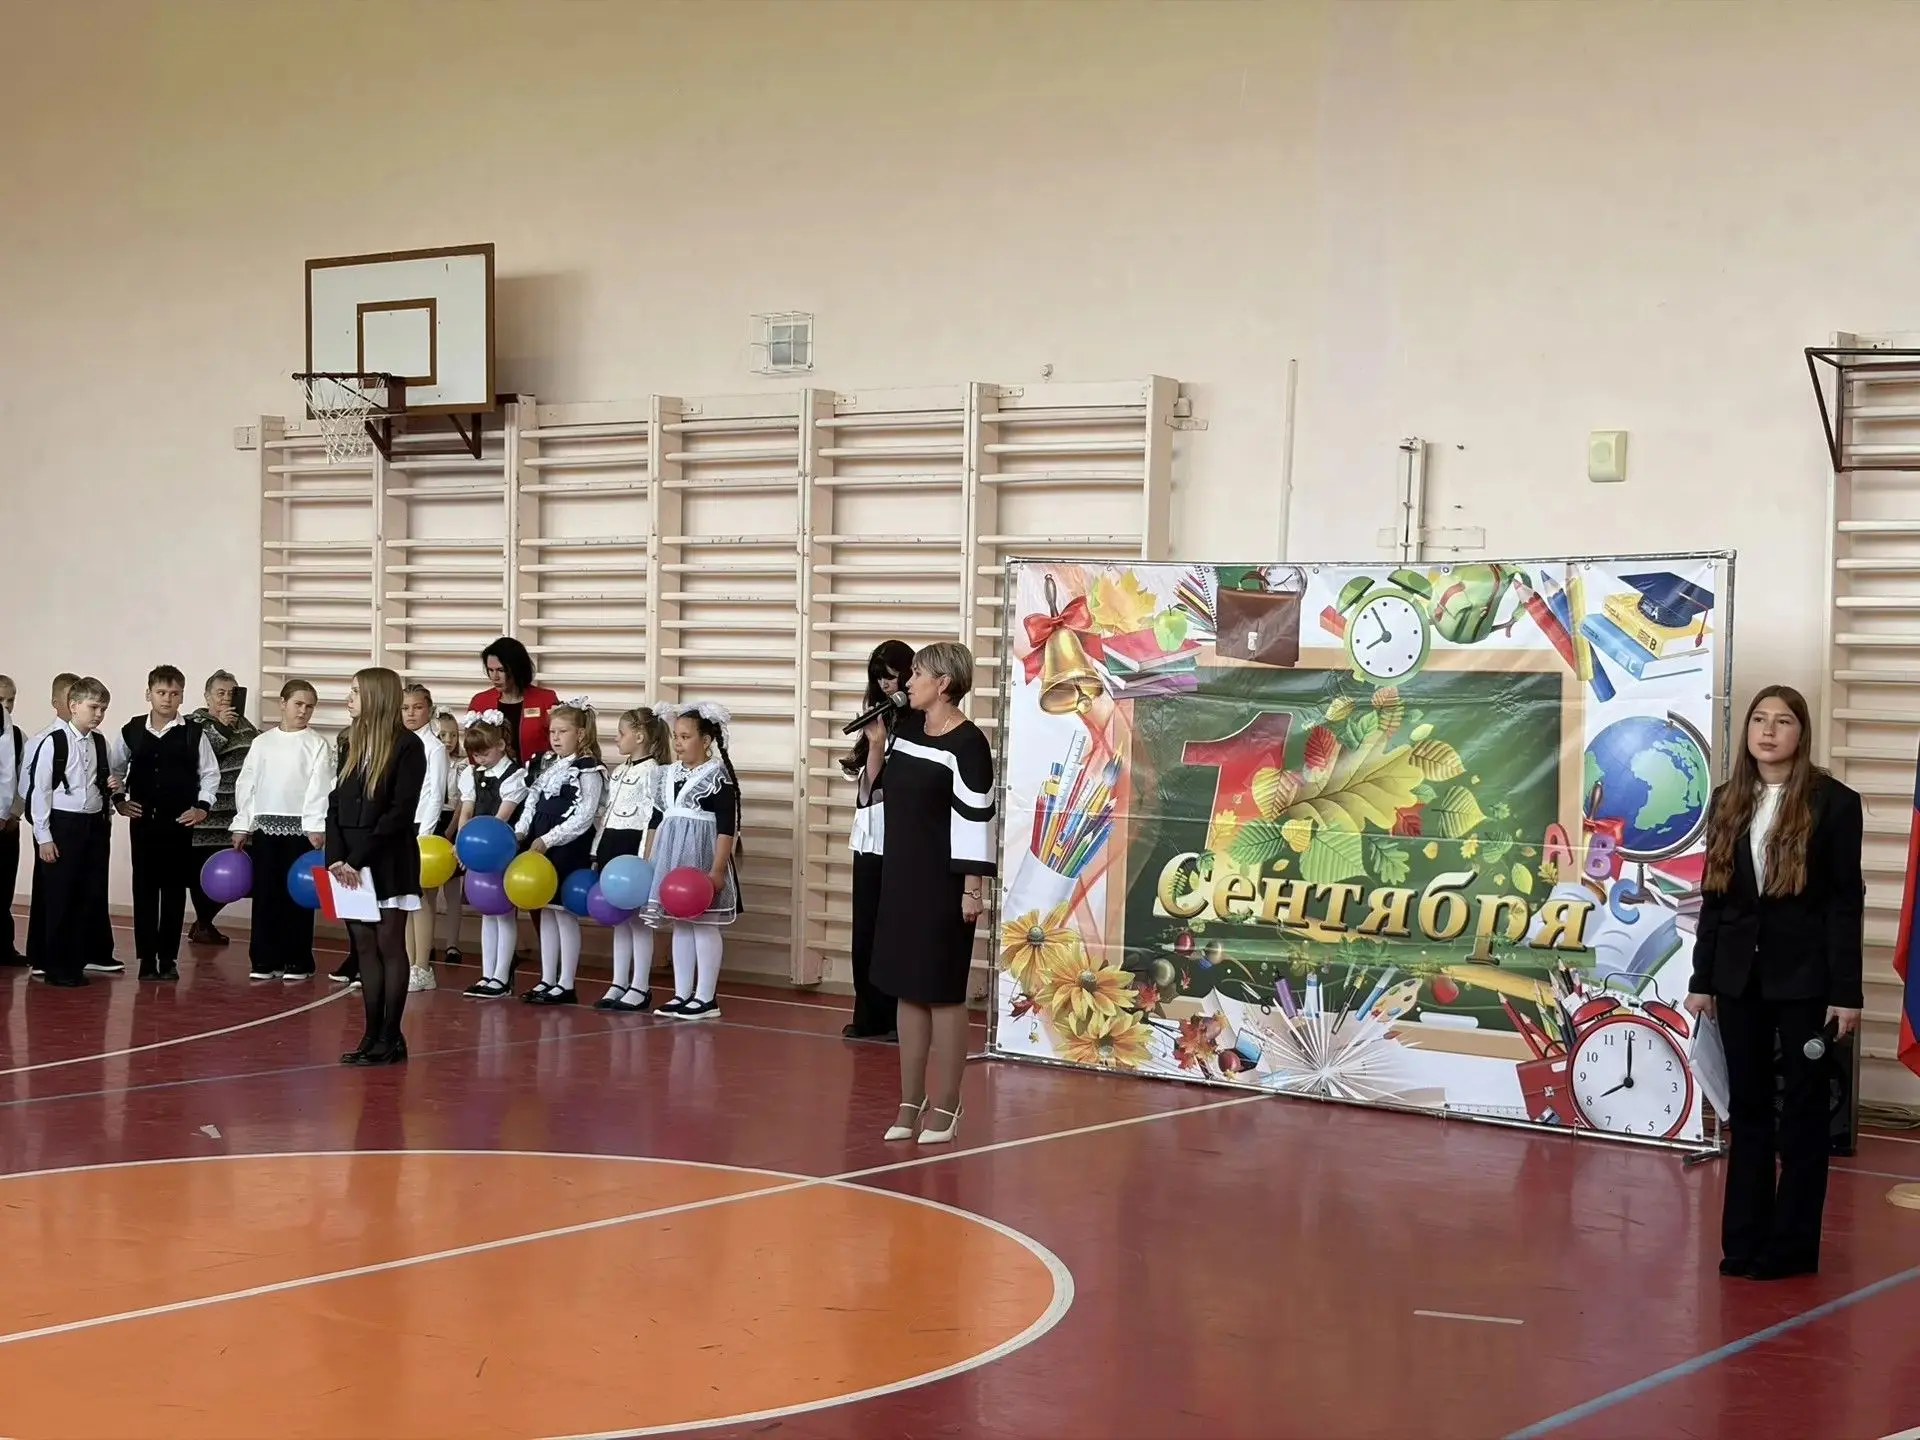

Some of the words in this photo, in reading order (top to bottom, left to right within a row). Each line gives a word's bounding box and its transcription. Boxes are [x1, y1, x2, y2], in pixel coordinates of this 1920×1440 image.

[1649, 638, 1657, 651] B
[1152, 711, 1295, 922] 1
[1156, 852, 1597, 966] Сентября
[1603, 1034, 1615, 1046] 11
[1624, 1030, 1636, 1041] 12
[1586, 1052, 1599, 1063] 10
[1665, 1061, 1673, 1072] 2
[1579, 1071, 1587, 1082] 9
[1671, 1082, 1678, 1093] 3
[1586, 1096, 1593, 1107] 8
[1664, 1103, 1671, 1115] 4
[1605, 1116, 1612, 1127] 7
[1648, 1121, 1655, 1132] 5
[1624, 1123, 1632, 1134] 6
